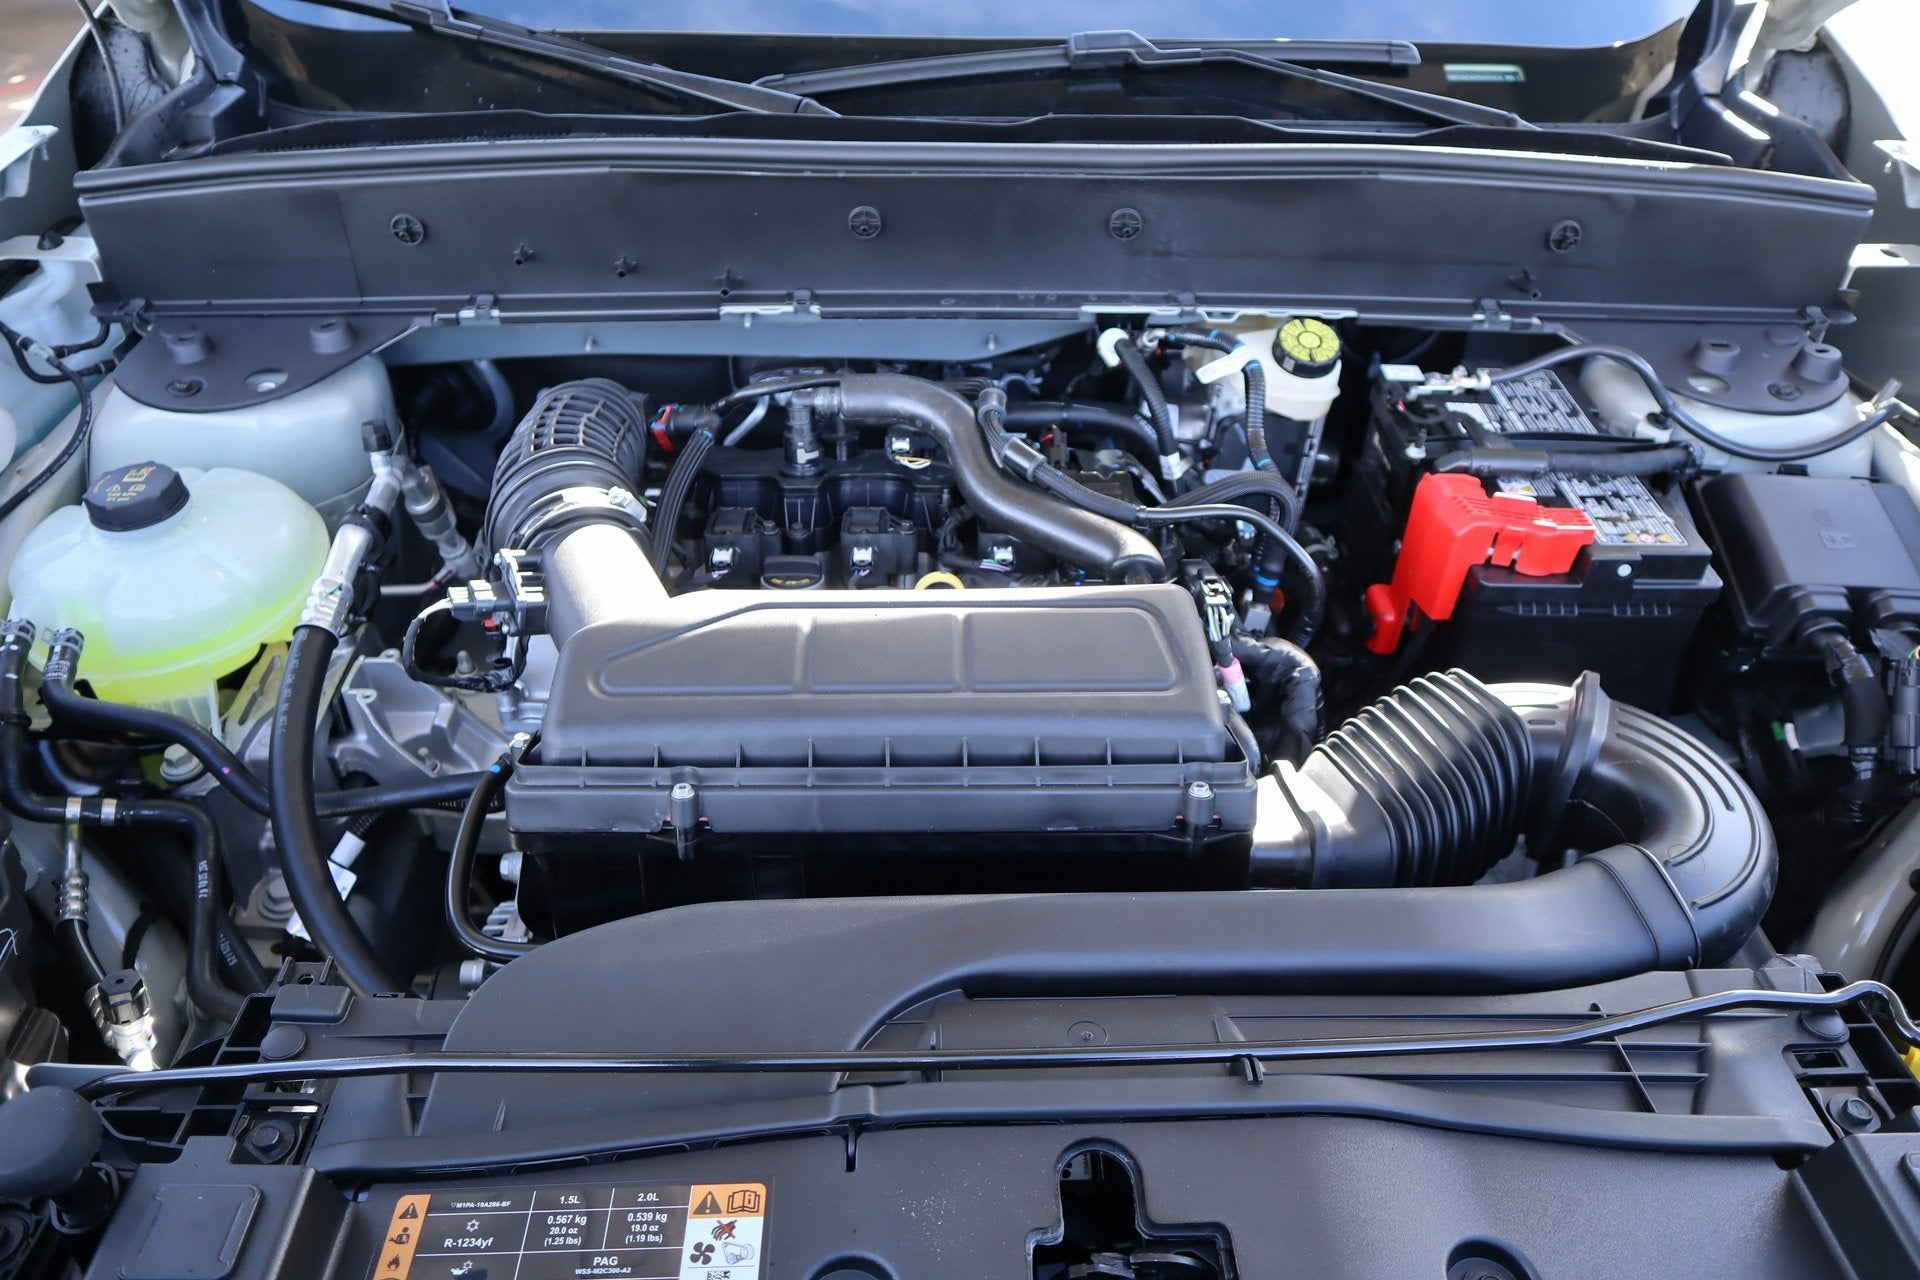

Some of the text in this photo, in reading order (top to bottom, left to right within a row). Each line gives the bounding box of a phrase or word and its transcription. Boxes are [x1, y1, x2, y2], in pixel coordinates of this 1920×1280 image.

[559, 1195, 580, 1204] 1.5L
[637, 1193, 659, 1202] 2.0L
[547, 1214, 587, 1225] 0.567 kg
[627, 1212, 668, 1223] 0.539 kg
[549, 1227, 566, 1235] 20.0
[630, 1224, 647, 1232] 19.0
[443, 1237, 494, 1249] R-1234yf
[544, 1236, 582, 1247] (1.25 lbs)
[625, 1234, 663, 1244] (1.19 lbs)
[593, 1256, 618, 1266] PAG
